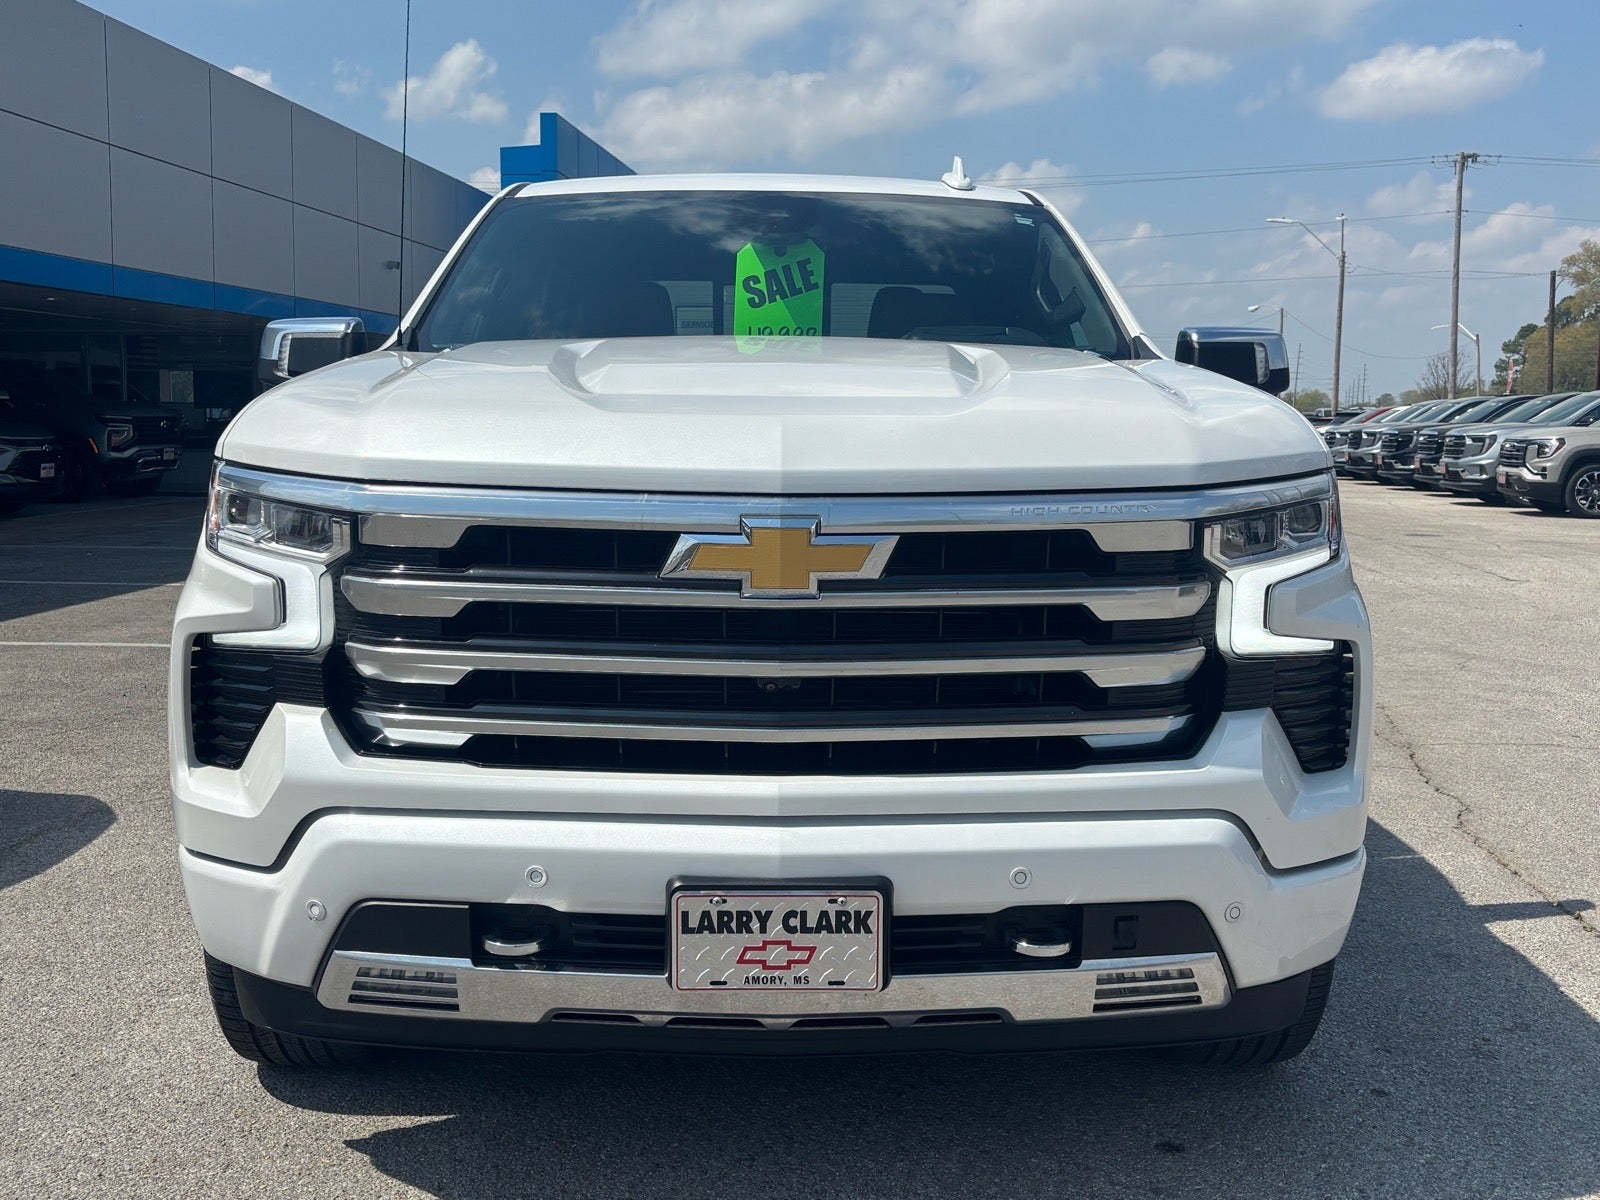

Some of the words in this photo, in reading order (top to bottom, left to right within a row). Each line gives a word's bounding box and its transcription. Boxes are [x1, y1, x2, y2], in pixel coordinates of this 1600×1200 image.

[742, 257, 819, 309] SALE
[1011, 507, 1059, 517] HIGH
[1068, 504, 1160, 515] COUNTRY
[681, 910, 773, 935] LARRY
[781, 909, 874, 935] CLARK
[743, 975, 787, 986] AMORY,
[793, 975, 810, 985] MS
